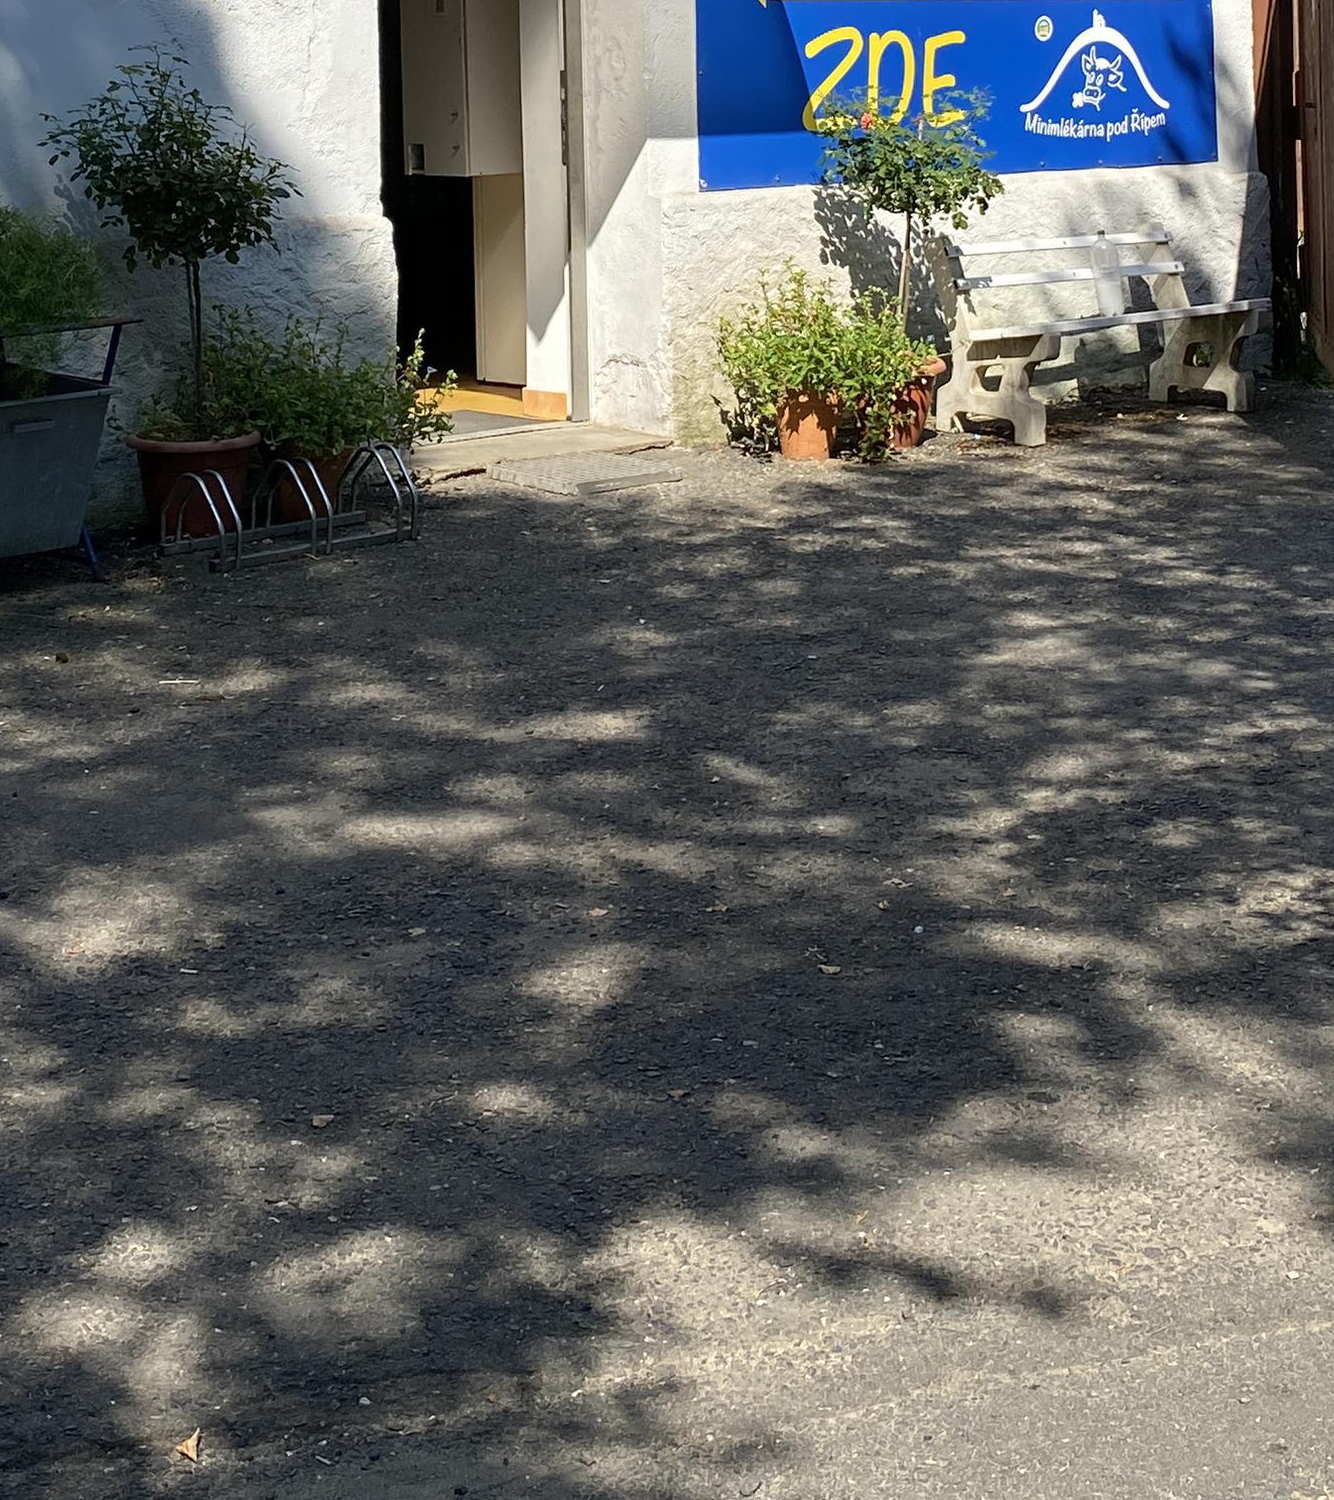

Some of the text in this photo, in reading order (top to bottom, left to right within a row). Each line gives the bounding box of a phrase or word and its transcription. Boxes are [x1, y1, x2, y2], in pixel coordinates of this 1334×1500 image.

[803, 26, 966, 132] ZDE
[1025, 108, 1166, 142] Minimlékárna pod Řípem
